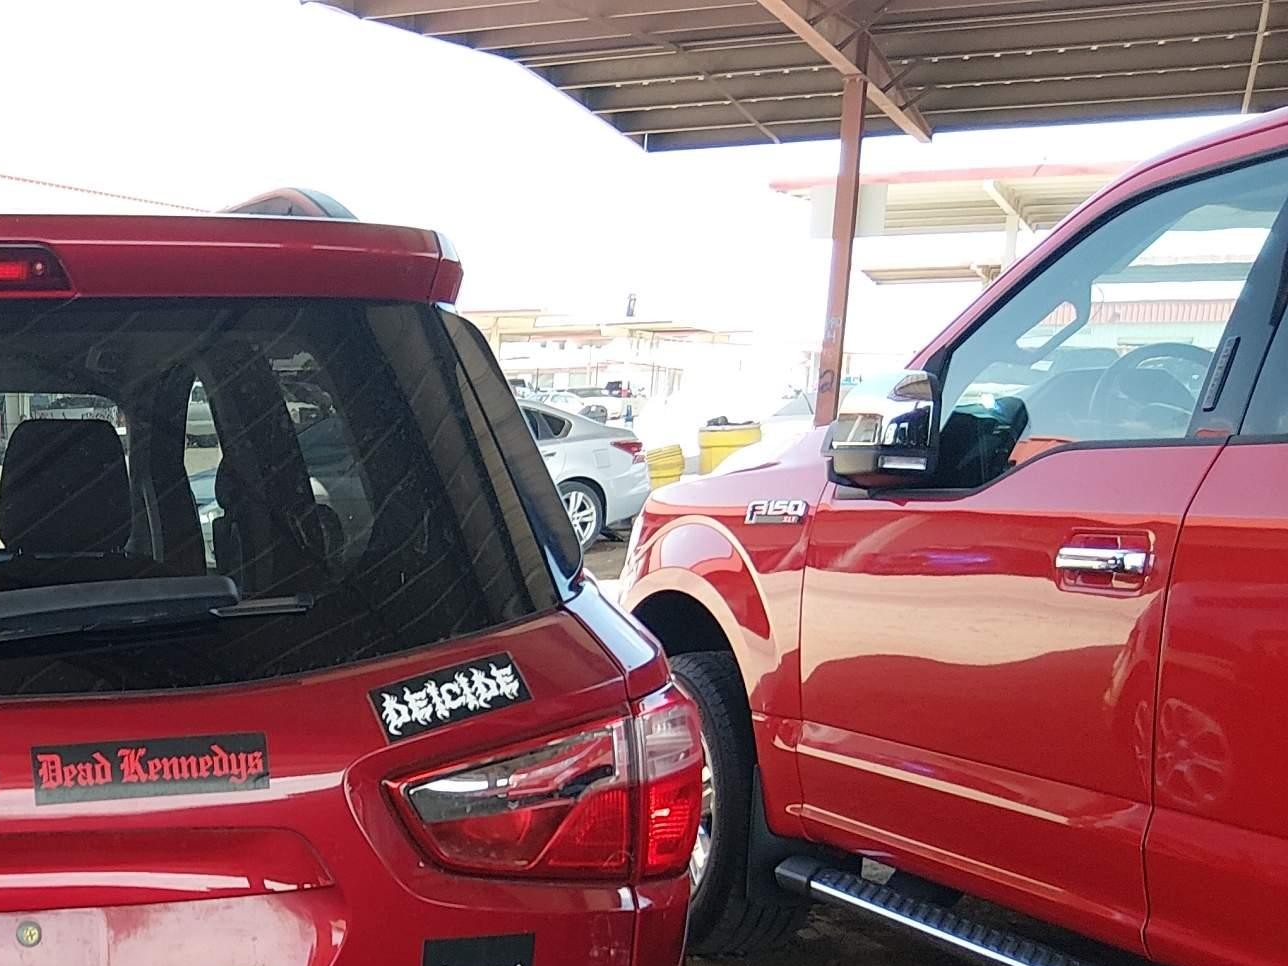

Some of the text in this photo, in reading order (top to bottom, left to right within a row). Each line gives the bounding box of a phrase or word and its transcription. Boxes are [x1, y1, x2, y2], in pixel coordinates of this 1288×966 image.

[381, 662, 520, 736] DEICIDE
[36, 743, 263, 790] Dead Kennedys
